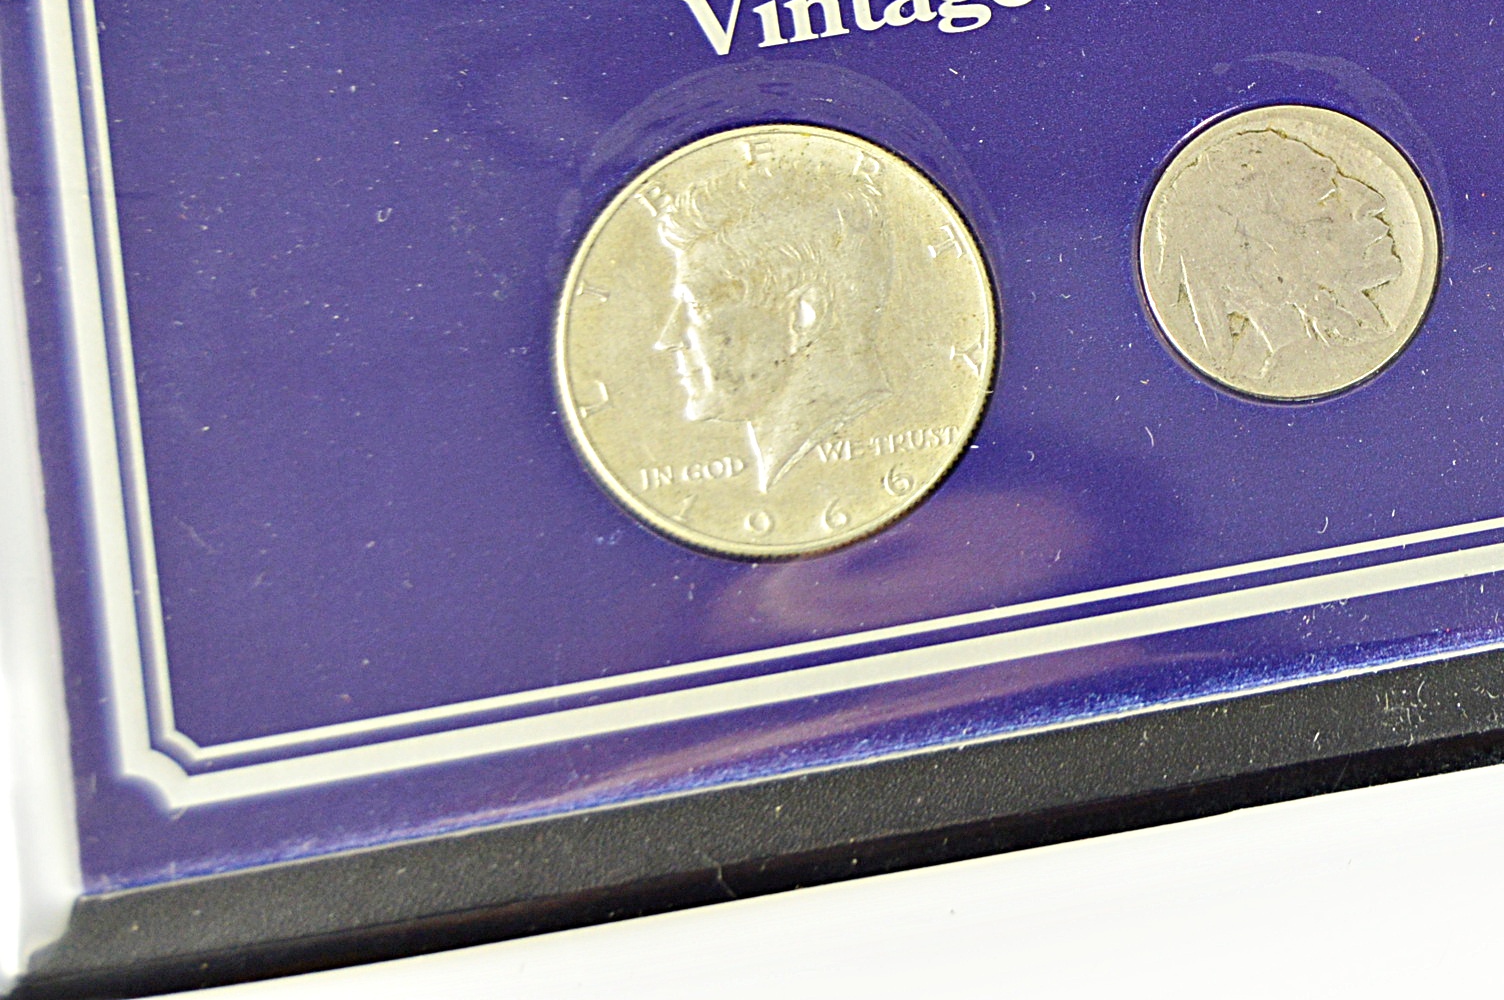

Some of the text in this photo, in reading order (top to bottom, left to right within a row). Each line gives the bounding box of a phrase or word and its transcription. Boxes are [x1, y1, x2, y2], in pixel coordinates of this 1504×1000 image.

[639, 425, 960, 490] IN GOD WE TRUST
